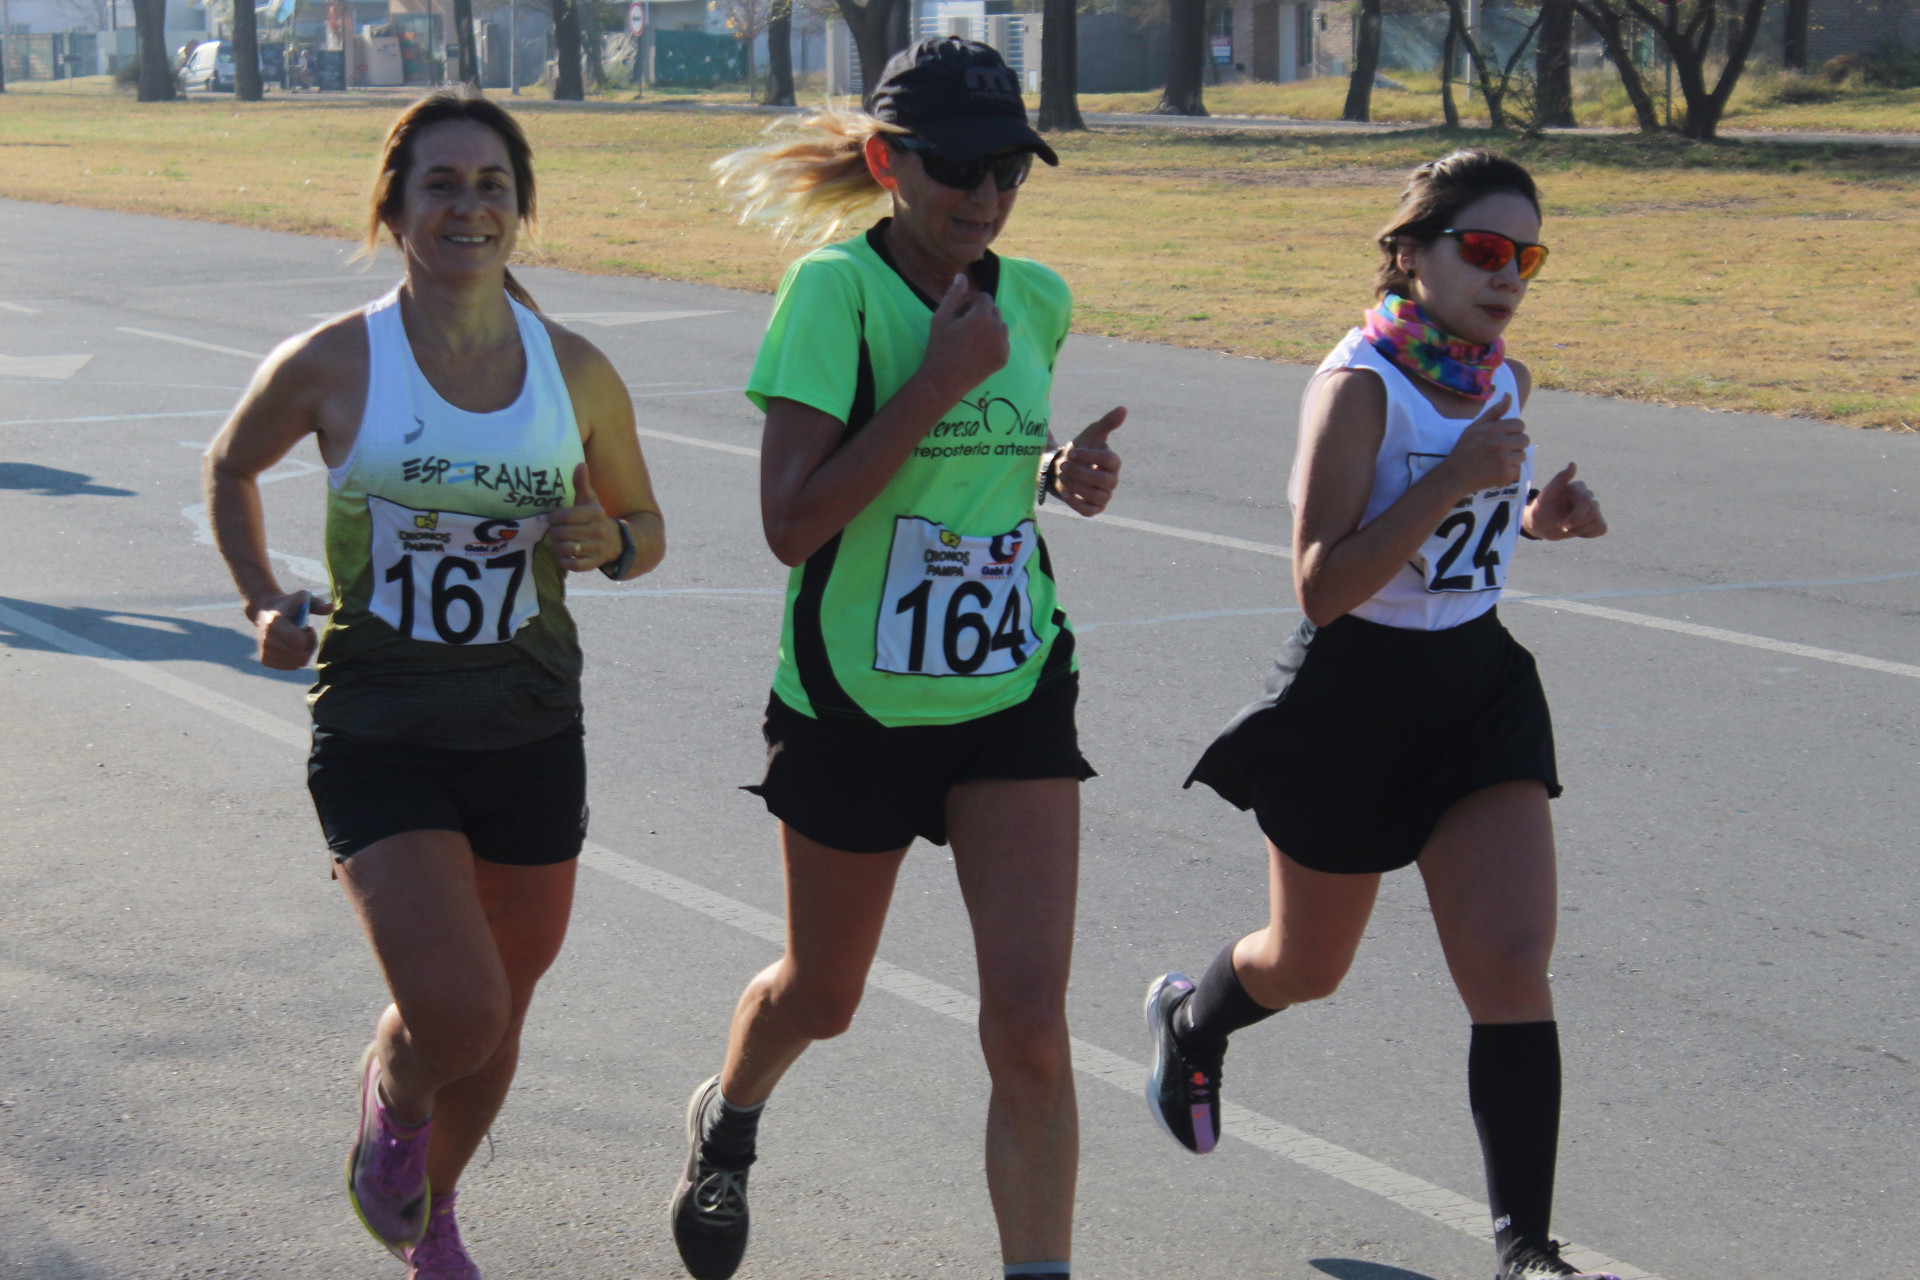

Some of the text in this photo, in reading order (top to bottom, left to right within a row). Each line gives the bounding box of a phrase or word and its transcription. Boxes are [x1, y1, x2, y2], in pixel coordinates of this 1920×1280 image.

[927, 420, 980, 438] eresa
[924, 549, 971, 566] CRONOS
[926, 564, 965, 576] PAMPA
[1429, 500, 1511, 590] 24
[385, 550, 526, 645] 167
[896, 580, 1027, 675] 164
